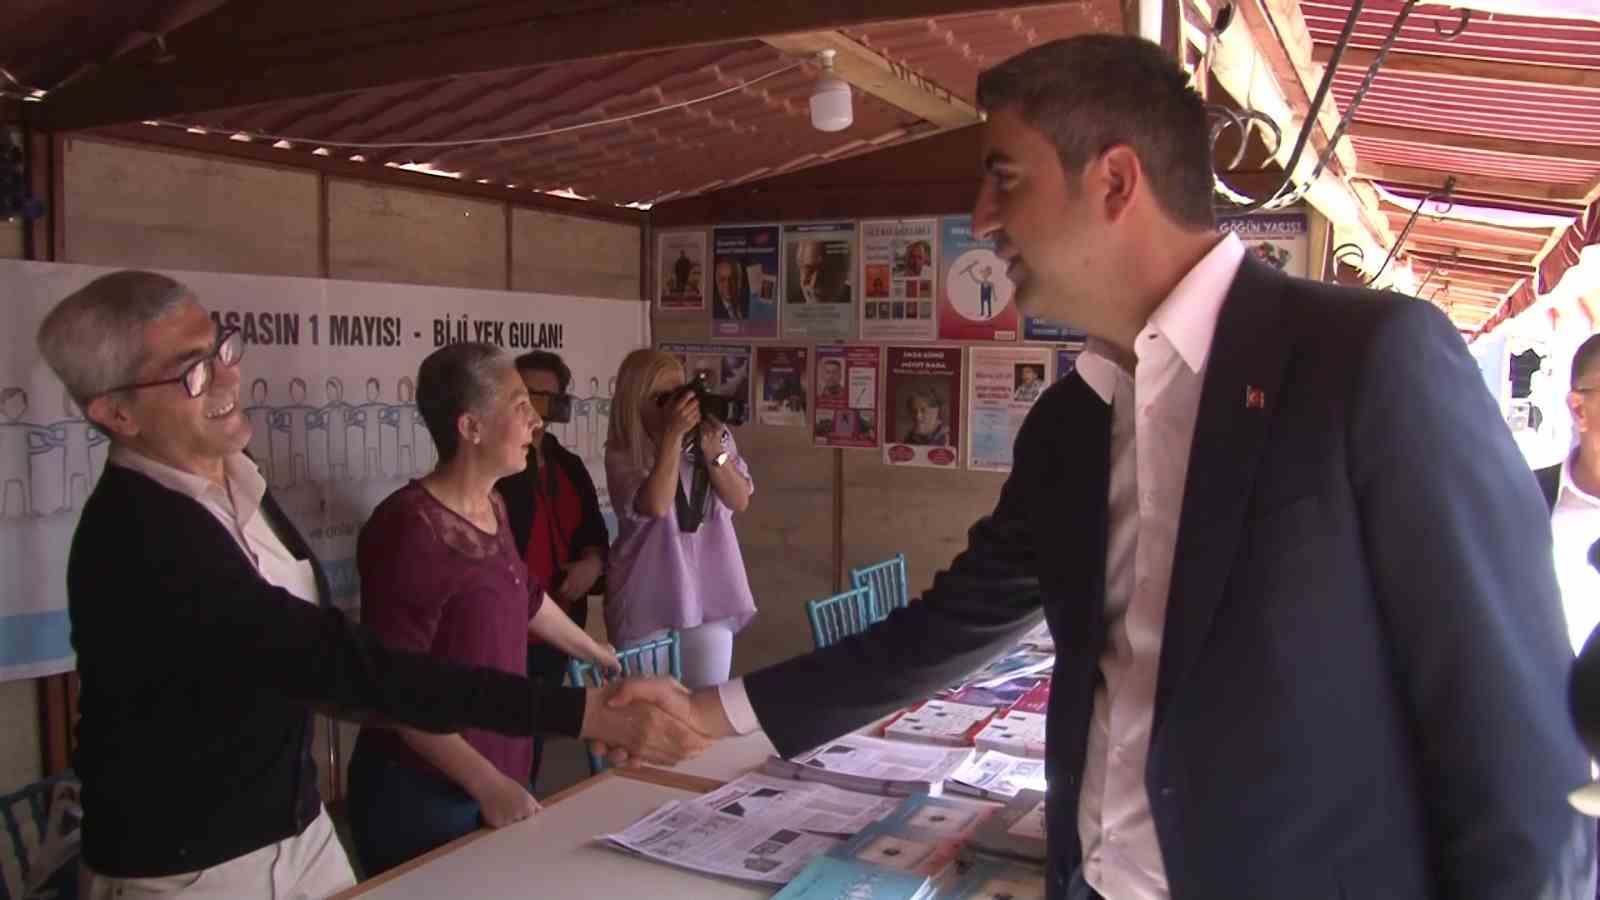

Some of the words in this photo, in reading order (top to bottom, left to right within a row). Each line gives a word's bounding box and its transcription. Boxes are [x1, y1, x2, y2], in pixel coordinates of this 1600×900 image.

[309, 314, 319, 345] 1
[329, 315, 401, 346] MAYIS!
[473, 320, 504, 347] YEK
[509, 321, 563, 349] GULAN!
